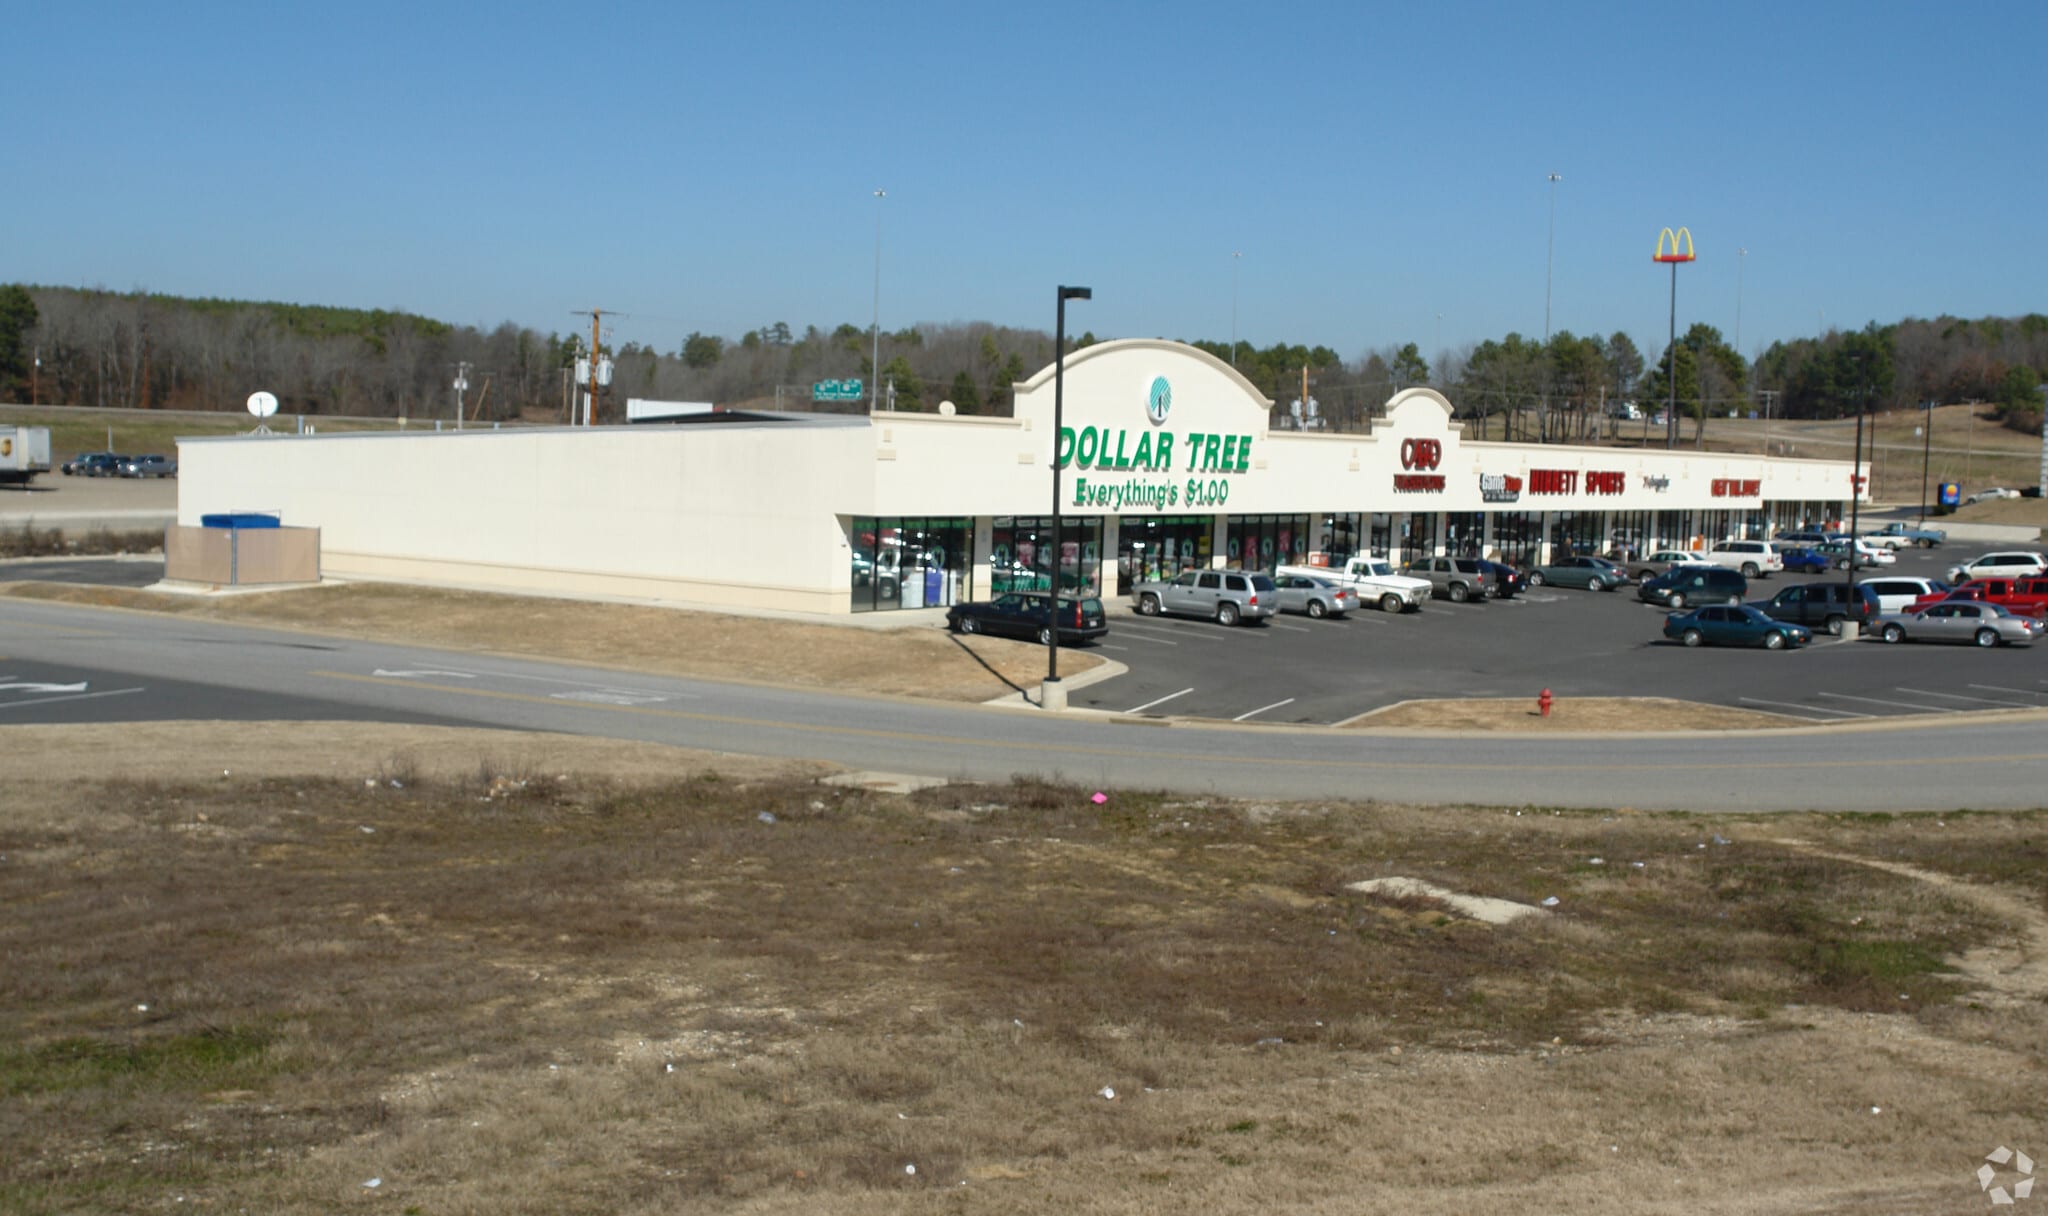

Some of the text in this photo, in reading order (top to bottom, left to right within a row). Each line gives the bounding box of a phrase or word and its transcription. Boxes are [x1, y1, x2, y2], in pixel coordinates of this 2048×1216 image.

[1058, 425, 1253, 471] DOLLAR TREE
[1075, 477, 1229, 508] Everything's $1.00
[1585, 470, 1626, 495] SPORTS
